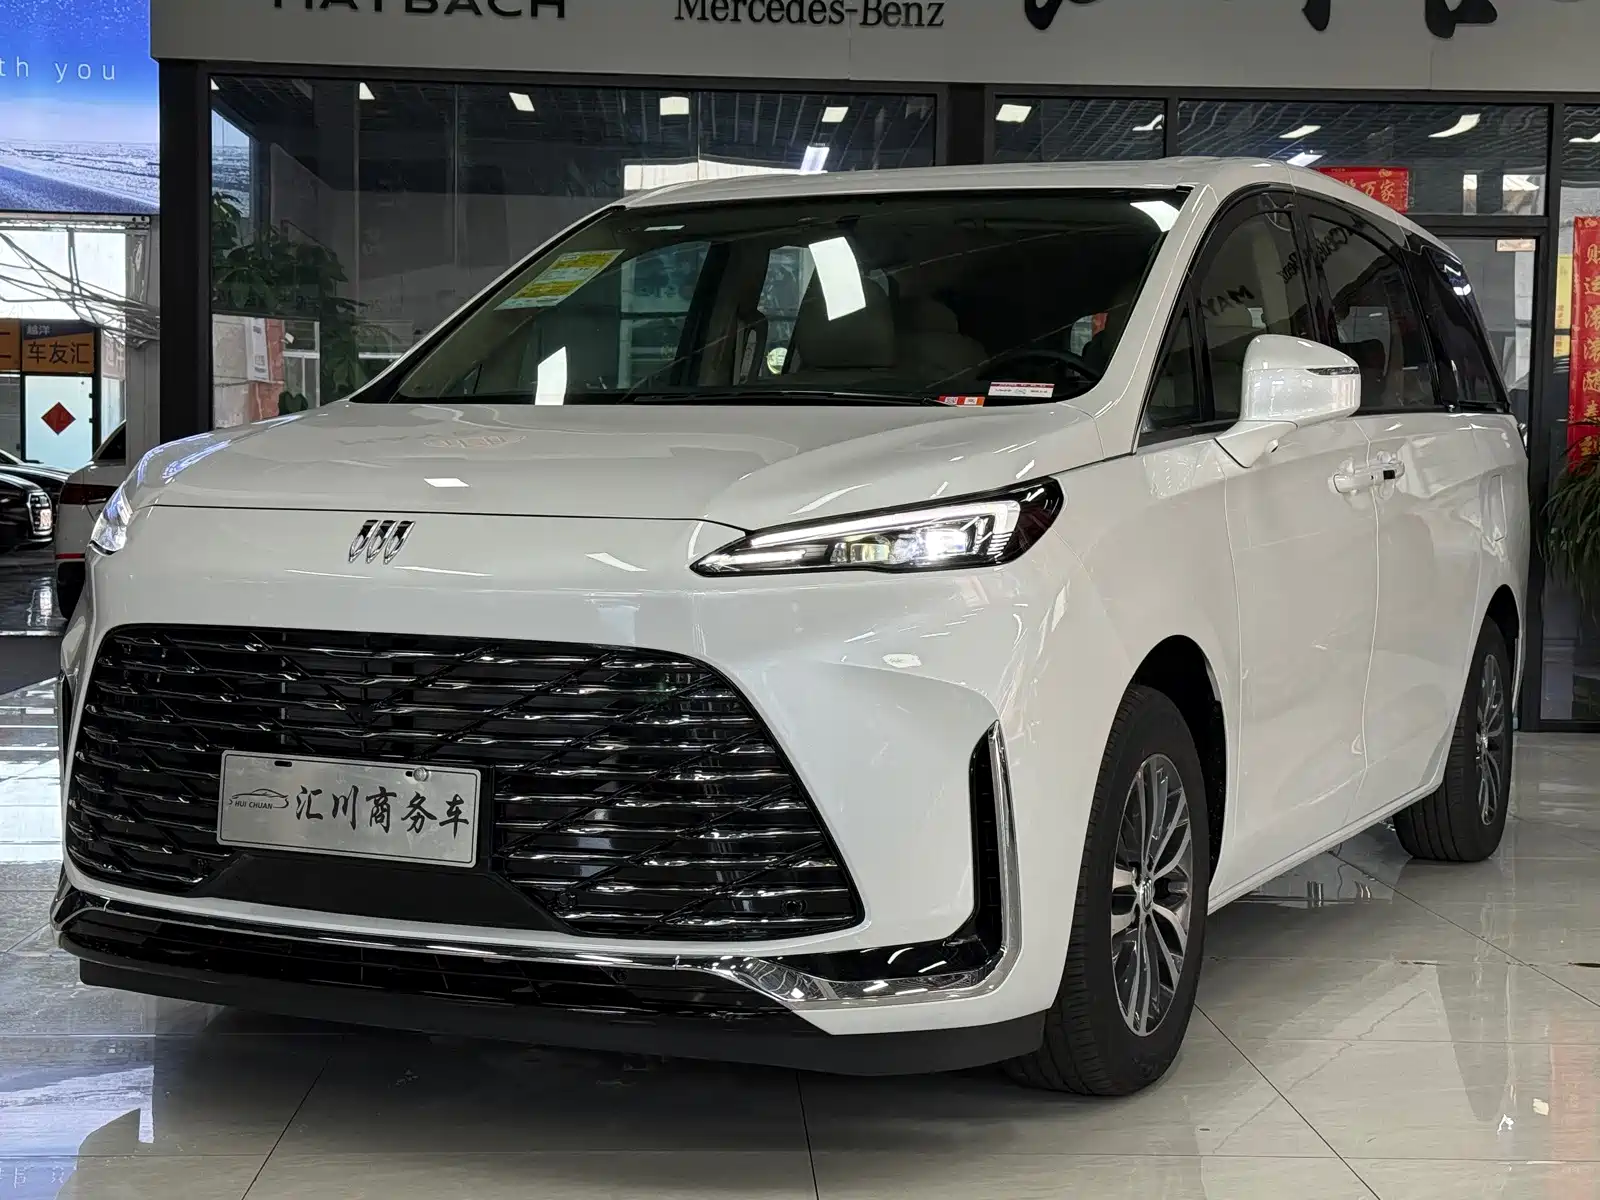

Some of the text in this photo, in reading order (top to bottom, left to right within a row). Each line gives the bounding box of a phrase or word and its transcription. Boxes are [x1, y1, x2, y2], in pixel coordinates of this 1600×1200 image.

[674, 0, 945, 27] Mercedes-Benz
[54, 63, 115, 83] you
[27, 341, 91, 365] 车友汇
[234, 800, 273, 809] HUI CHUAN
[295, 784, 469, 839] 汇川商务车
